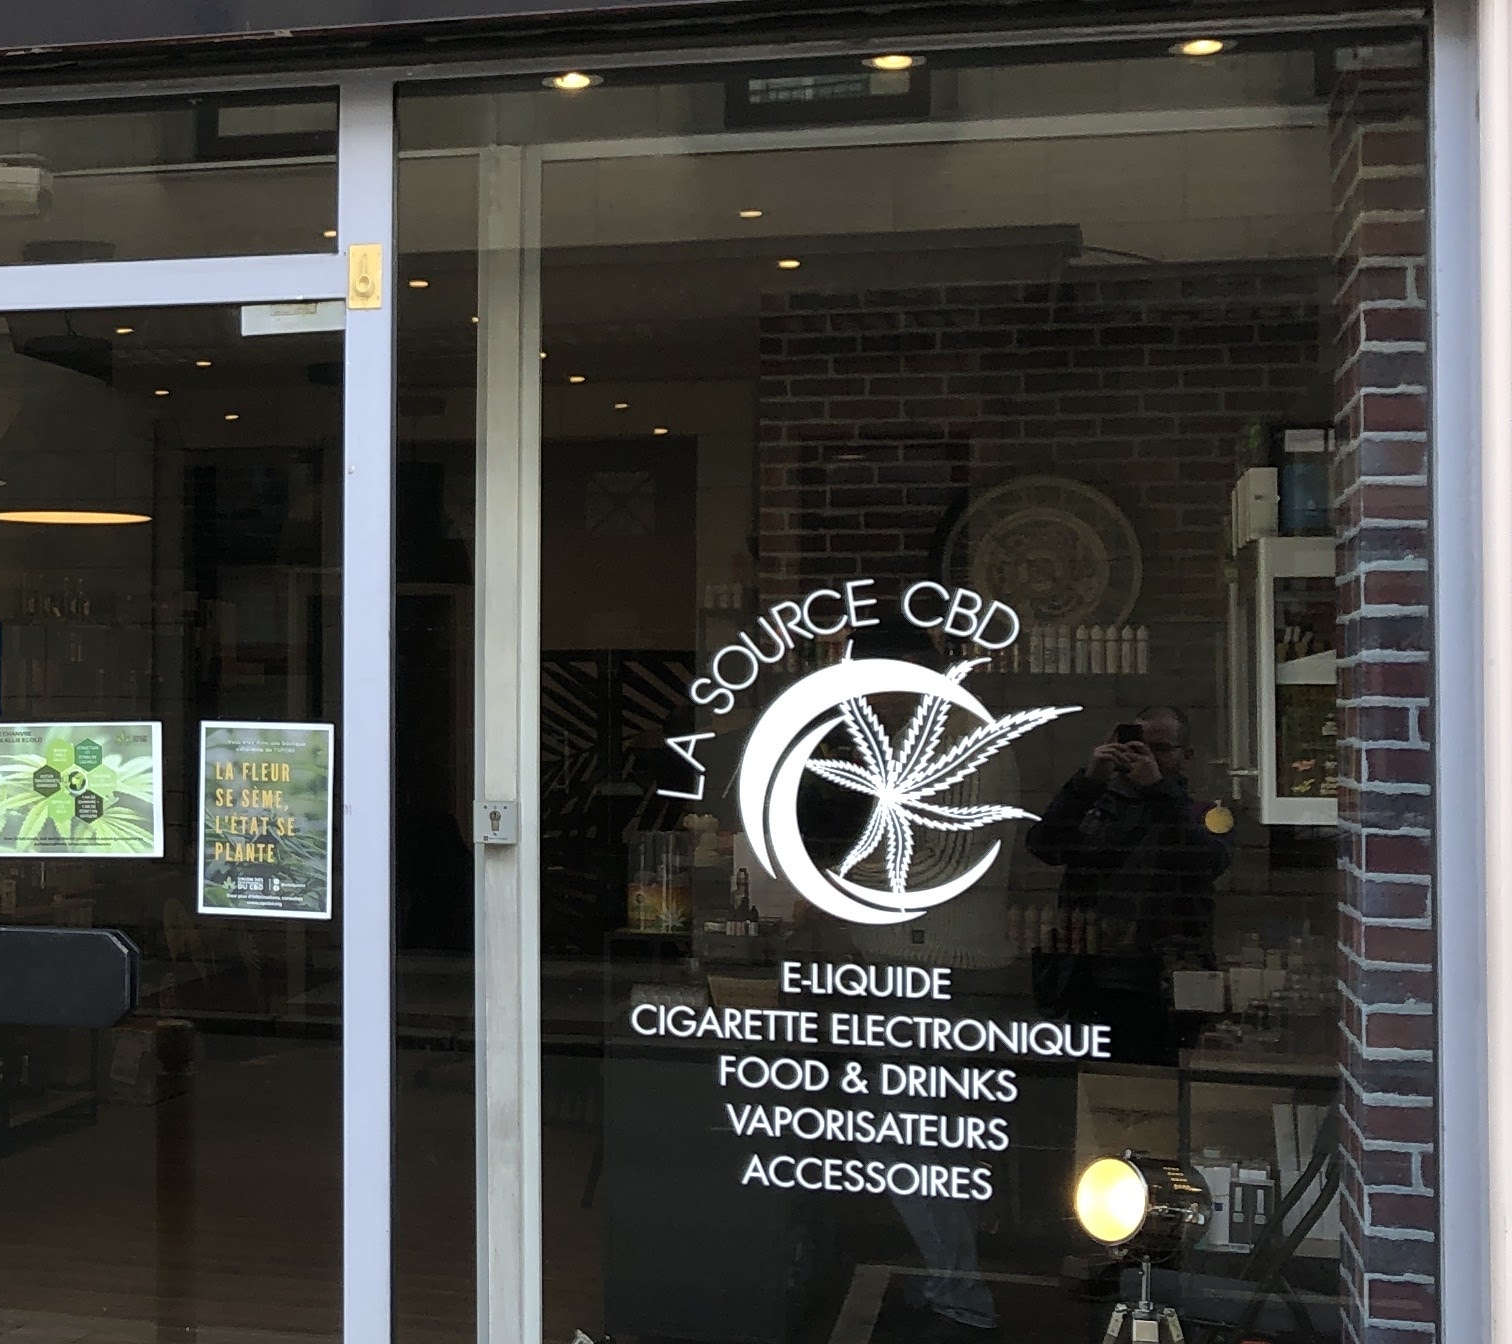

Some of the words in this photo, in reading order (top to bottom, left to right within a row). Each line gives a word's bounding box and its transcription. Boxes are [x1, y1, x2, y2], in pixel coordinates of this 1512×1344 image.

[656, 730, 716, 801] LA
[690, 578, 881, 715] SOURCE
[901, 581, 1020, 650] CBD
[215, 761, 234, 781] LA
[242, 762, 291, 782] FLEUR
[215, 788, 234, 808] SE
[241, 786, 289, 812] SÈME,
[215, 812, 269, 836] L'ÉTAT
[276, 817, 296, 837] SE
[214, 842, 275, 864] PLANTE
[782, 961, 952, 1000] E-LIQUIDE
[630, 1003, 818, 1044] CIGARETTE
[830, 1013, 1112, 1058] ELECTRONIQUE
[719, 1056, 829, 1092] FOOD
[841, 1059, 870, 1094] &
[882, 1061, 1019, 1103] DRINKS
[726, 1103, 1010, 1150] VAPORISATEURS
[741, 1155, 994, 1200] ACCESSOIRES
